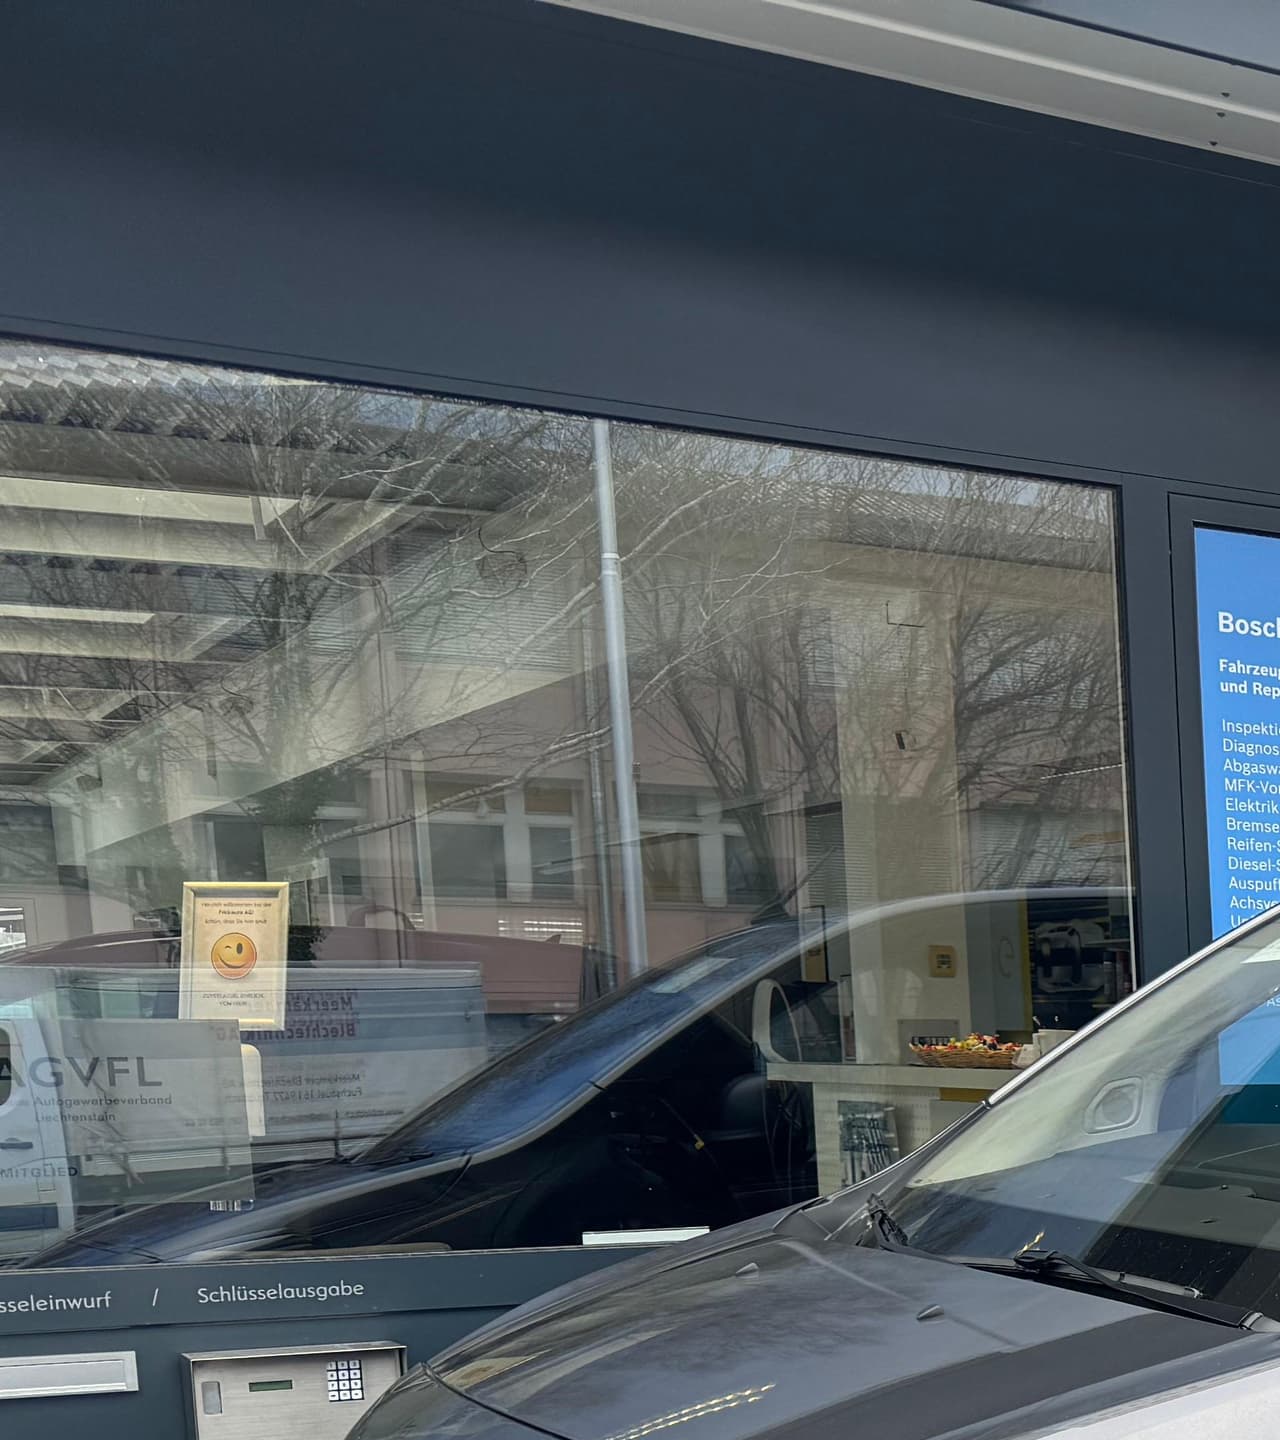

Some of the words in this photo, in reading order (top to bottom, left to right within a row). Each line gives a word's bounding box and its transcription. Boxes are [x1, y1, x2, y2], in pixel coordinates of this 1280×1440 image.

[1220, 681, 1248, 694] und
[1225, 797, 1279, 815] Elektrik
[0, 1291, 112, 1313] sseleinwurf
[198, 1280, 365, 1303] Schlüsselausgabe
